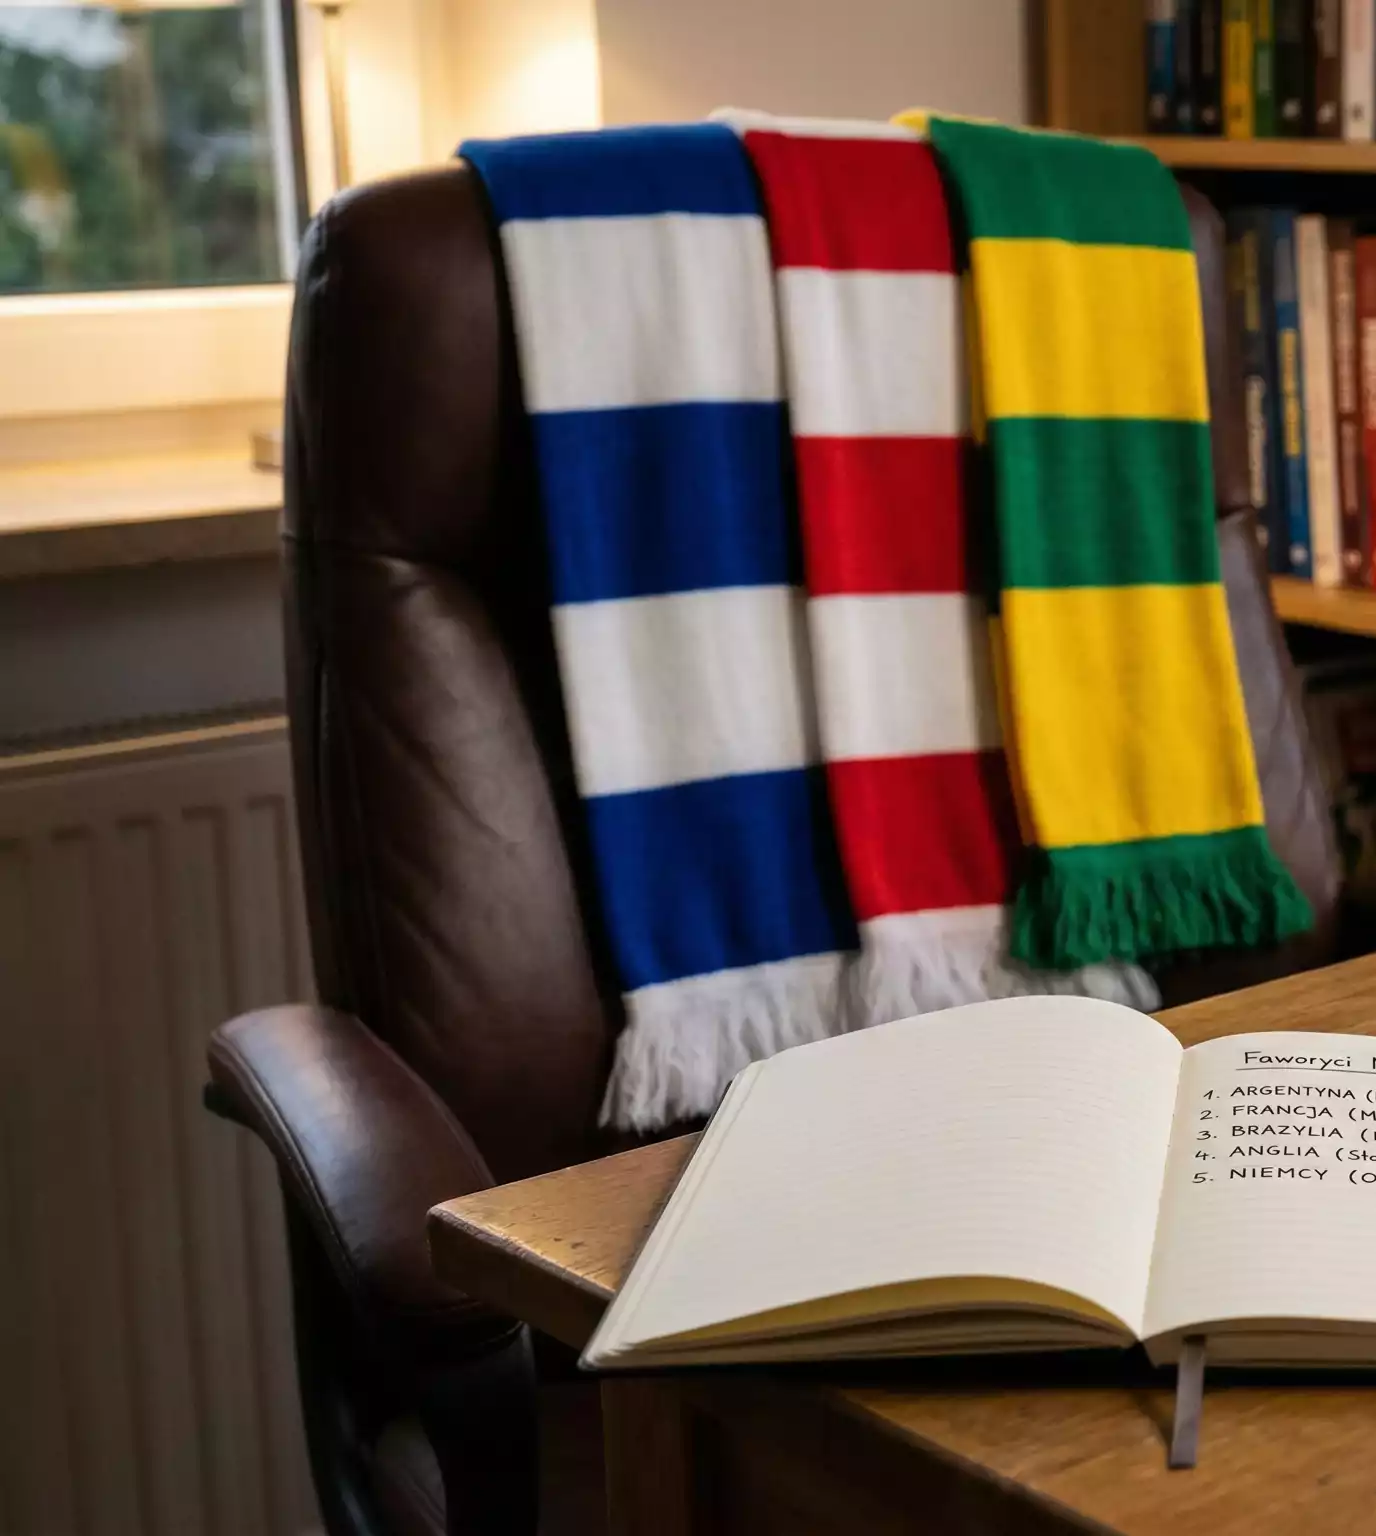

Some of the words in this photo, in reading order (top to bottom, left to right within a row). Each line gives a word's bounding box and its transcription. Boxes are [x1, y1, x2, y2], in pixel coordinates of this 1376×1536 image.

[1244, 1050, 1351, 1071] Faworyci
[1202, 1089, 1220, 1101] 1.
[1229, 1085, 1356, 1100] ARGENTYNA
[1199, 1109, 1219, 1121] 2.
[1232, 1104, 1334, 1120] FRANCJA
[1196, 1130, 1218, 1141] 3.
[1231, 1124, 1344, 1139] BRAZYLIA
[1194, 1150, 1216, 1161] 4.
[1228, 1144, 1321, 1158] ANGLIA
[1191, 1171, 1214, 1184] 5.
[1229, 1166, 1329, 1181] NIEMCY
